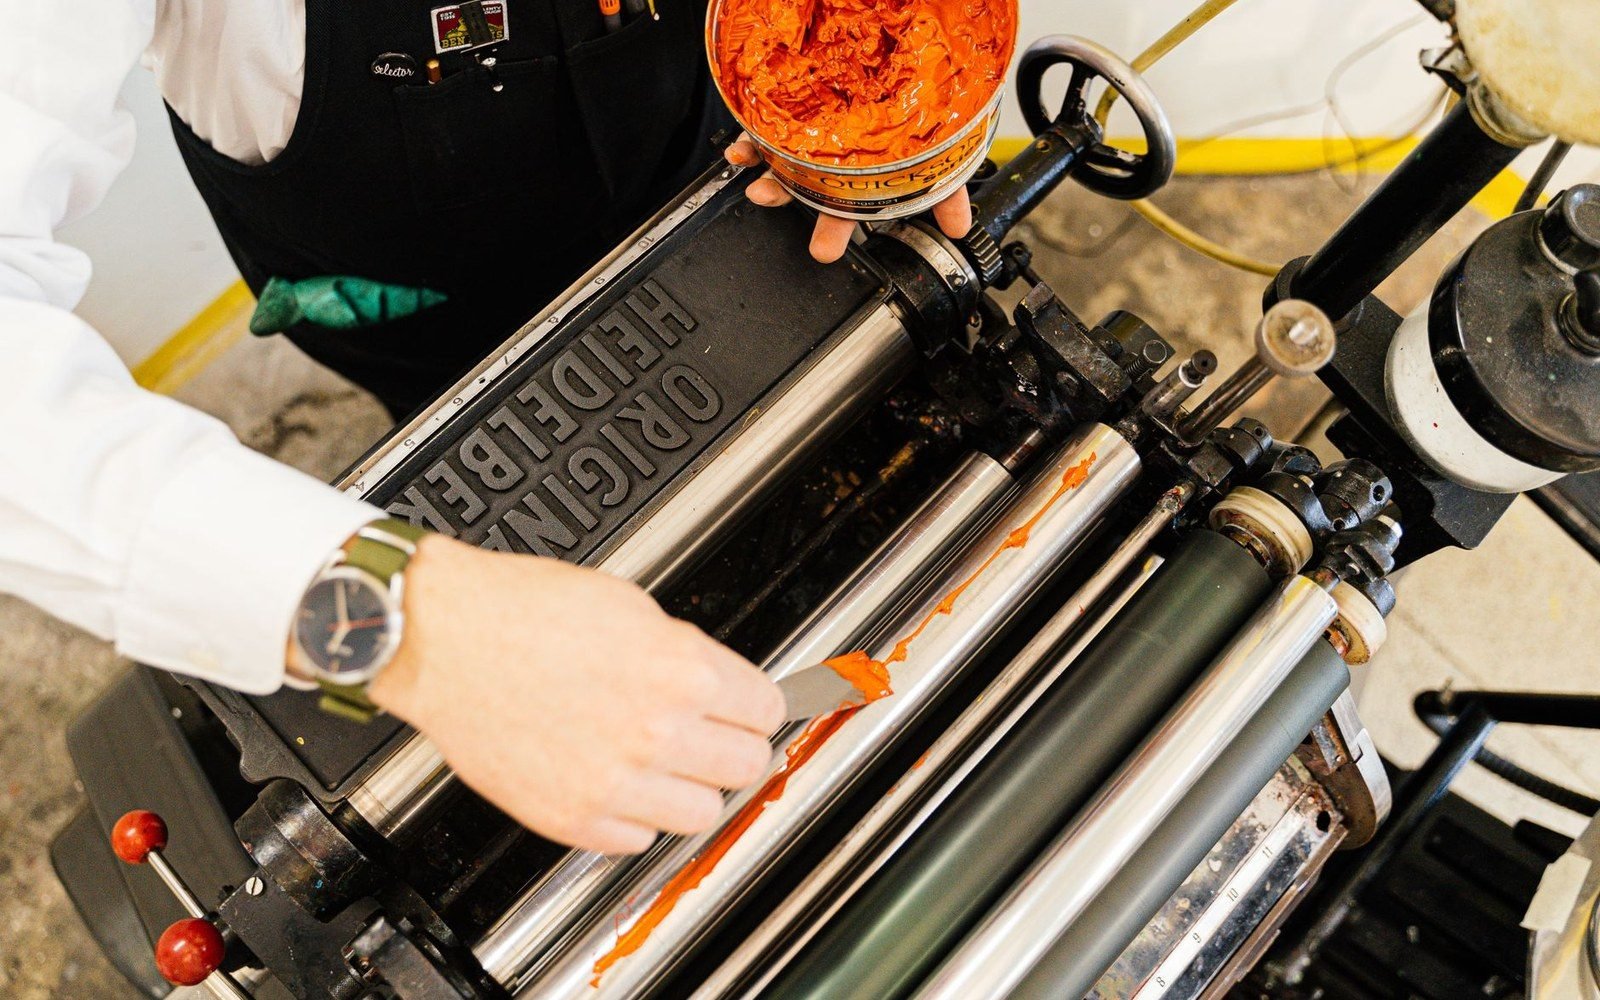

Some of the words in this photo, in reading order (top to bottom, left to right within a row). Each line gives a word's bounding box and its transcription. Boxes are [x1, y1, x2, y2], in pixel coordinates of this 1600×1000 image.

[441, 37, 466, 49] BEN
[683, 199, 699, 211] 11
[832, 197, 875, 206] Orange
[877, 197, 898, 206] 021
[637, 236, 655, 249] 10
[403, 438, 416, 450] 5
[1156, 976, 1166, 988] 8
[1192, 932, 1202, 944] 9
[1226, 887, 1239, 902] 10
[1262, 846, 1273, 859] 11
